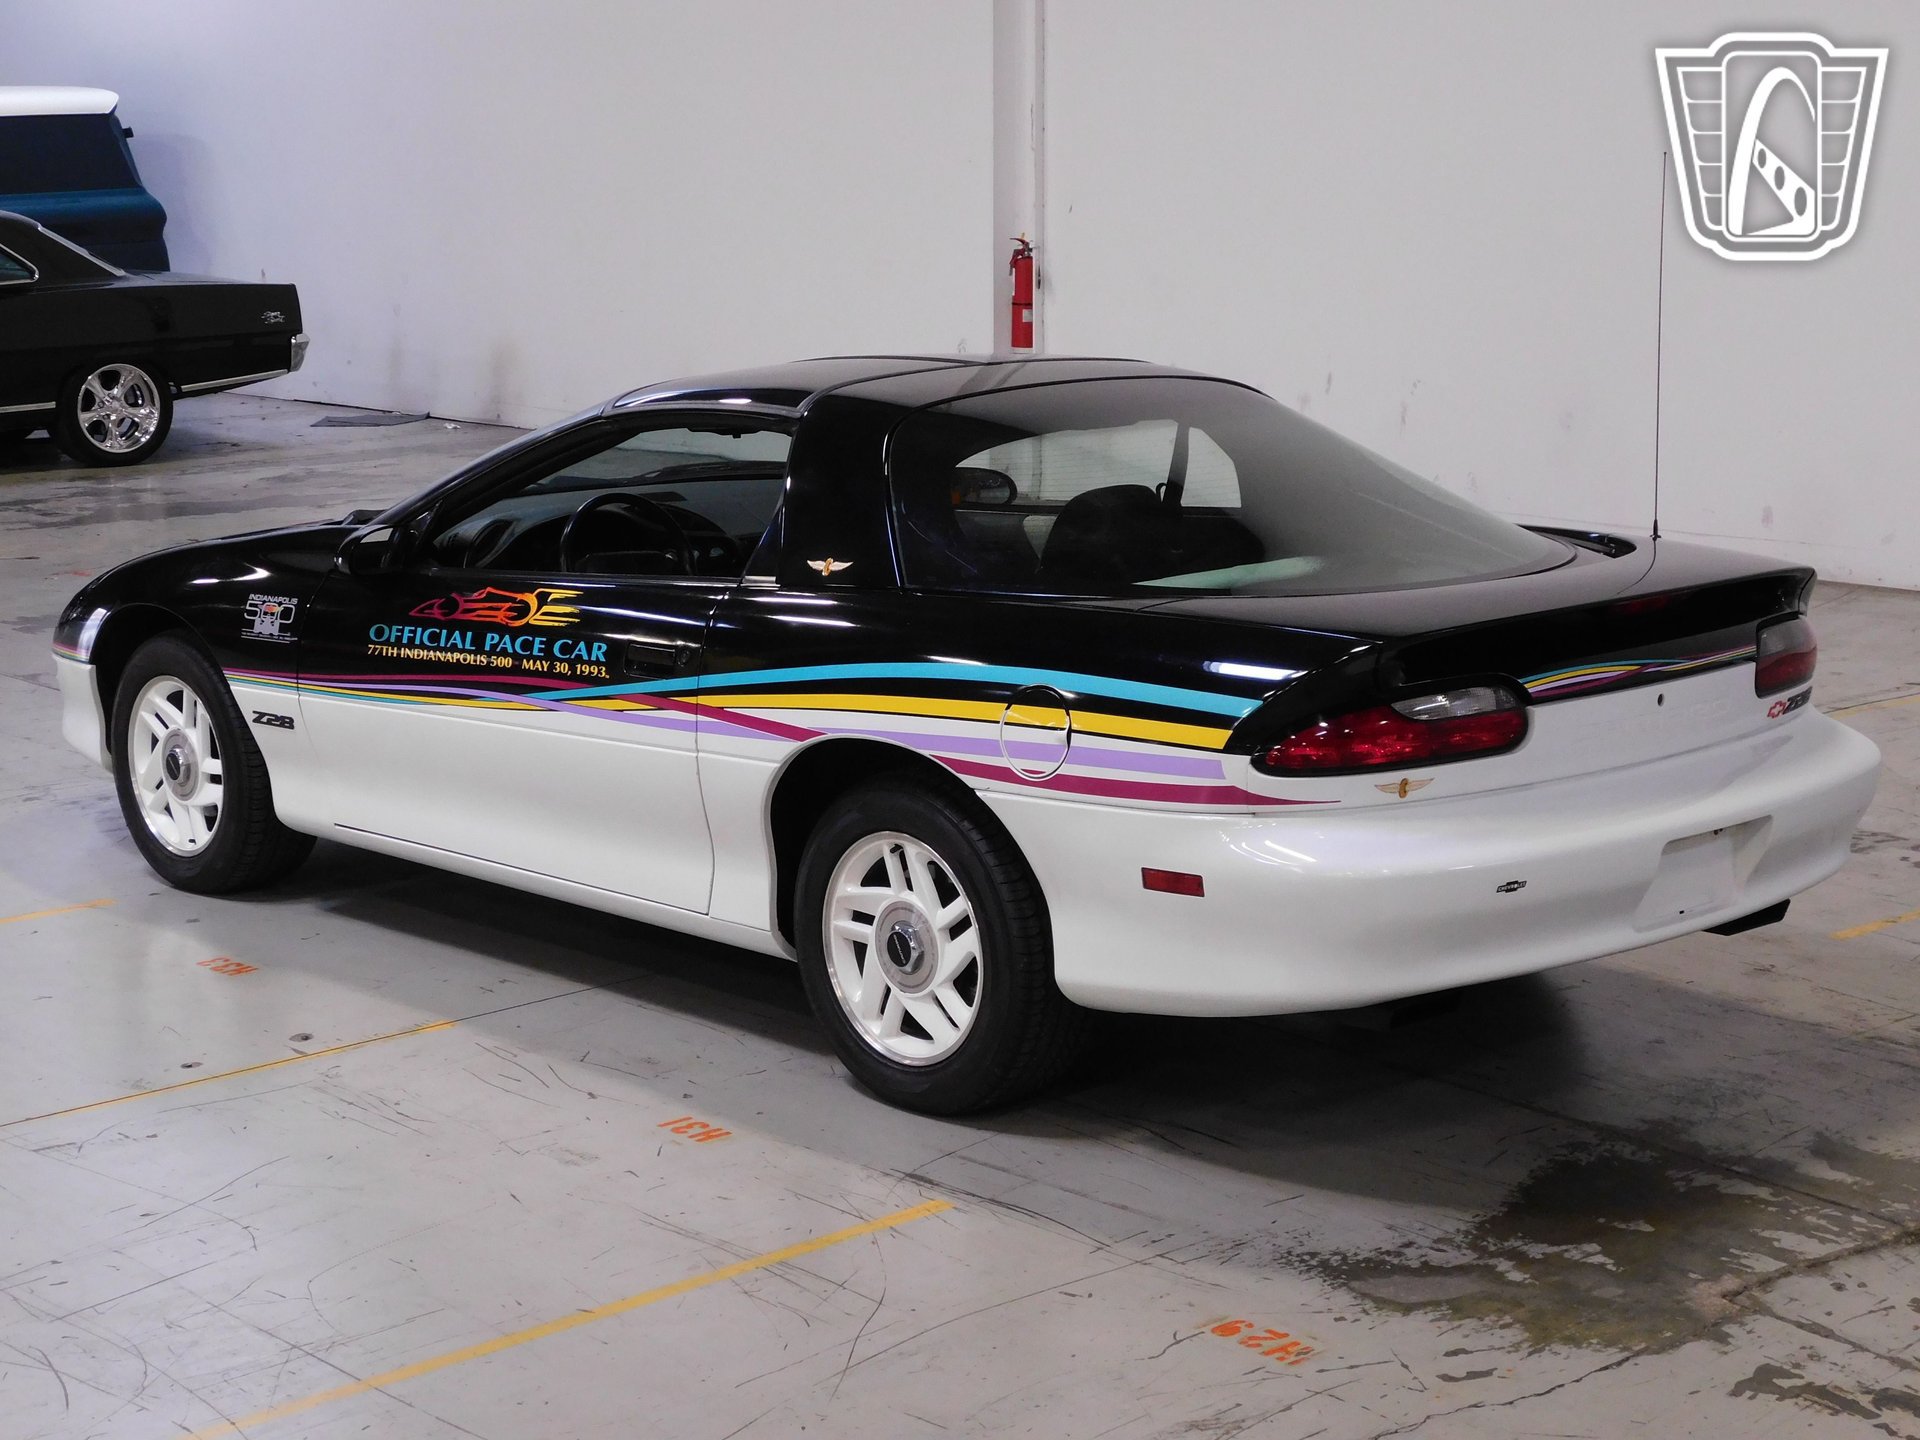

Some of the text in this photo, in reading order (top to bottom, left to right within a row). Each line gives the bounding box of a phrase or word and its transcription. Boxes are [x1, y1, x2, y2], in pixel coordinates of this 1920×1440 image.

[244, 600, 296, 624] 500
[248, 593, 299, 605] INDIANAPOLIS
[369, 623, 608, 662] OFFICIAL PACE CAR
[367, 644, 397, 658] 77TH
[400, 647, 488, 667] INDIANAPOLIS
[490, 655, 512, 668] 500
[521, 658, 551, 672] MAY
[552, 661, 572, 676] 30,
[252, 710, 295, 730] Z28
[1210, 1319, 1315, 1366] H29
